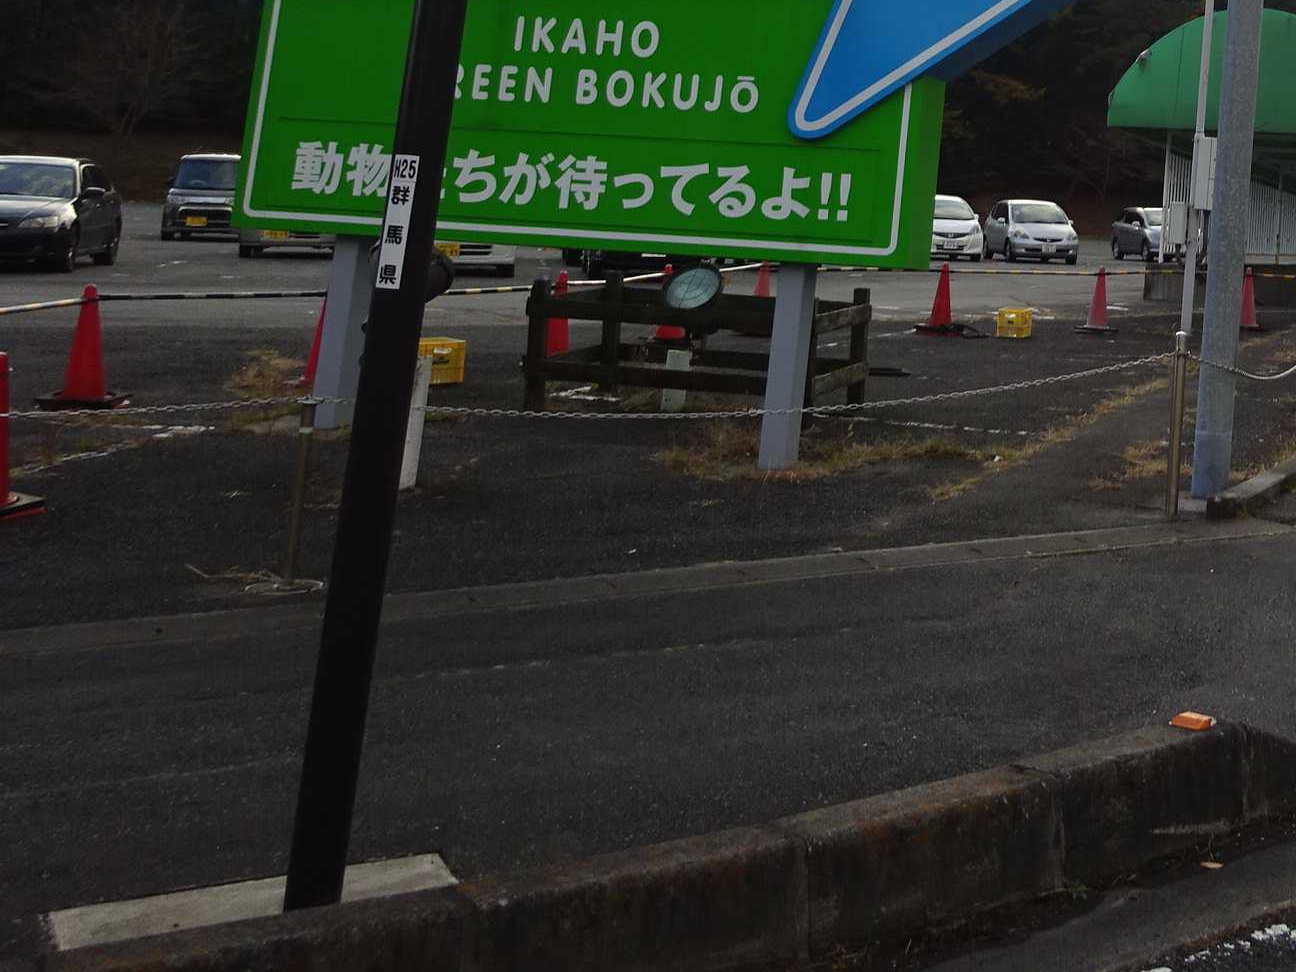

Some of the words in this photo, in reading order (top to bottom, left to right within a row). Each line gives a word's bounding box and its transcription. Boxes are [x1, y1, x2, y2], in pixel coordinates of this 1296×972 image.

[513, 15, 660, 59] IKAHO
[574, 68, 760, 114] BOKUJŌ
[290, 140, 853, 222] 動物ちが待ってるよ!!
[393, 157, 417, 179] H25
[378, 185, 411, 285] 群馬県
